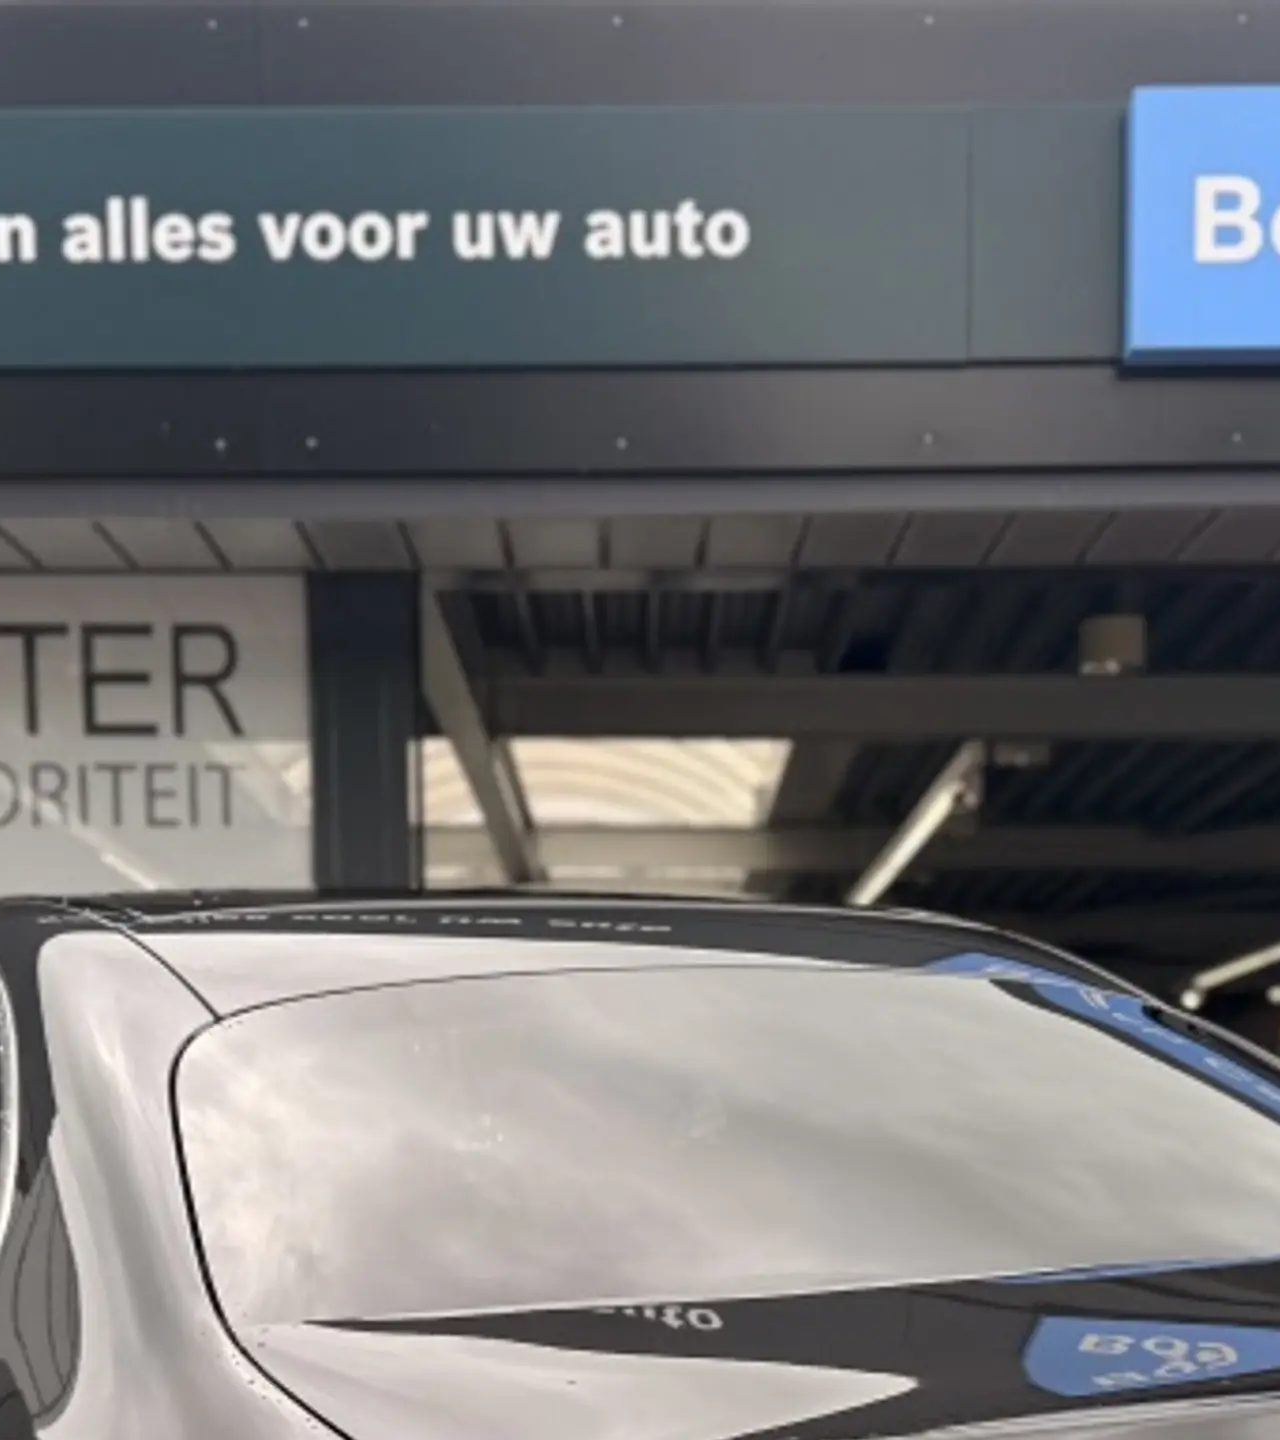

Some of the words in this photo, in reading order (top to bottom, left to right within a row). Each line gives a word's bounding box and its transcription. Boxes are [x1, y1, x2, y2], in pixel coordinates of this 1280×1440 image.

[62, 197, 236, 263] alles
[258, 206, 428, 261] voor
[452, 207, 560, 259] uw
[585, 199, 750, 259] auto
